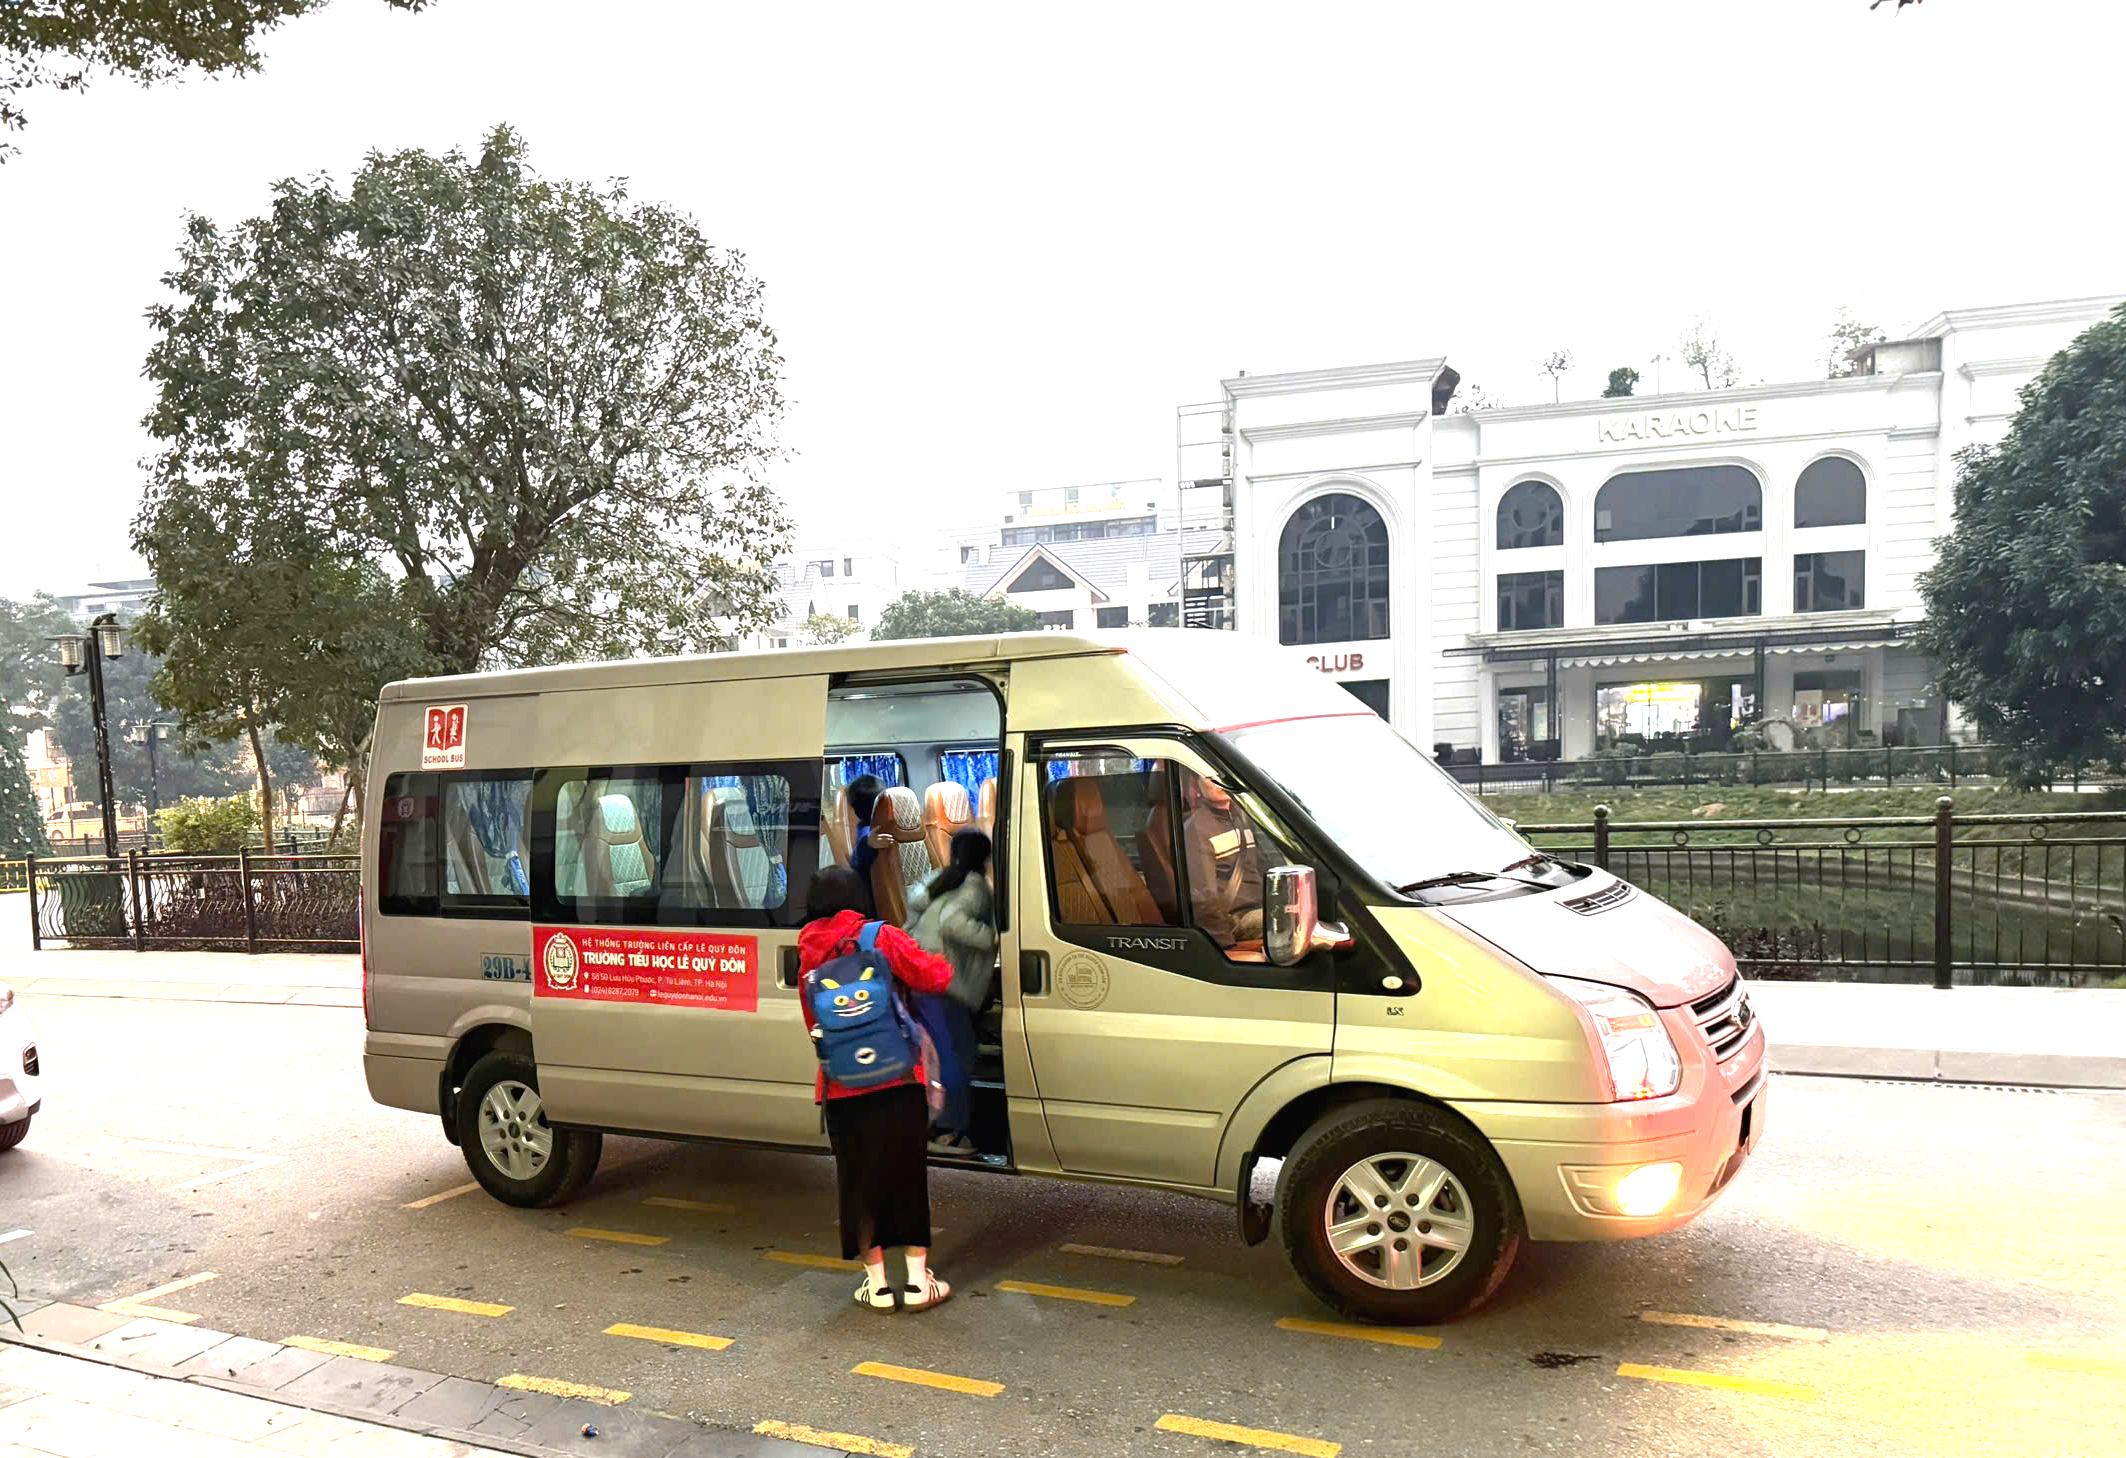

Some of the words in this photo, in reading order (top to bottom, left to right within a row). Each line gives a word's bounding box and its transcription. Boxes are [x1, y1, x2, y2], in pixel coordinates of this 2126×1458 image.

[1598, 407, 1758, 443] KARAOKE
[1306, 653, 1364, 673] CLUB
[424, 755, 449, 764] SCHOOL
[450, 754, 464, 763] BUS
[582, 937, 592, 948] HỆ
[595, 937, 620, 948] THỐNG
[658, 941, 675, 951] LIÊN
[678, 941, 693, 952] CẤP
[696, 942, 705, 952] LÊ
[708, 943, 725, 954] QUÝ
[728, 944, 746, 955] ĐÔN
[1106, 936, 1188, 951] TRANSIT
[628, 949, 649, 967] TIỂU
[652, 955, 675, 971] HỌC
[677, 954, 690, 969] LÊ
[692, 956, 717, 972] QUÝ
[720, 957, 746, 974] ĐÔN
[1384, 1004, 1405, 1017] LX
